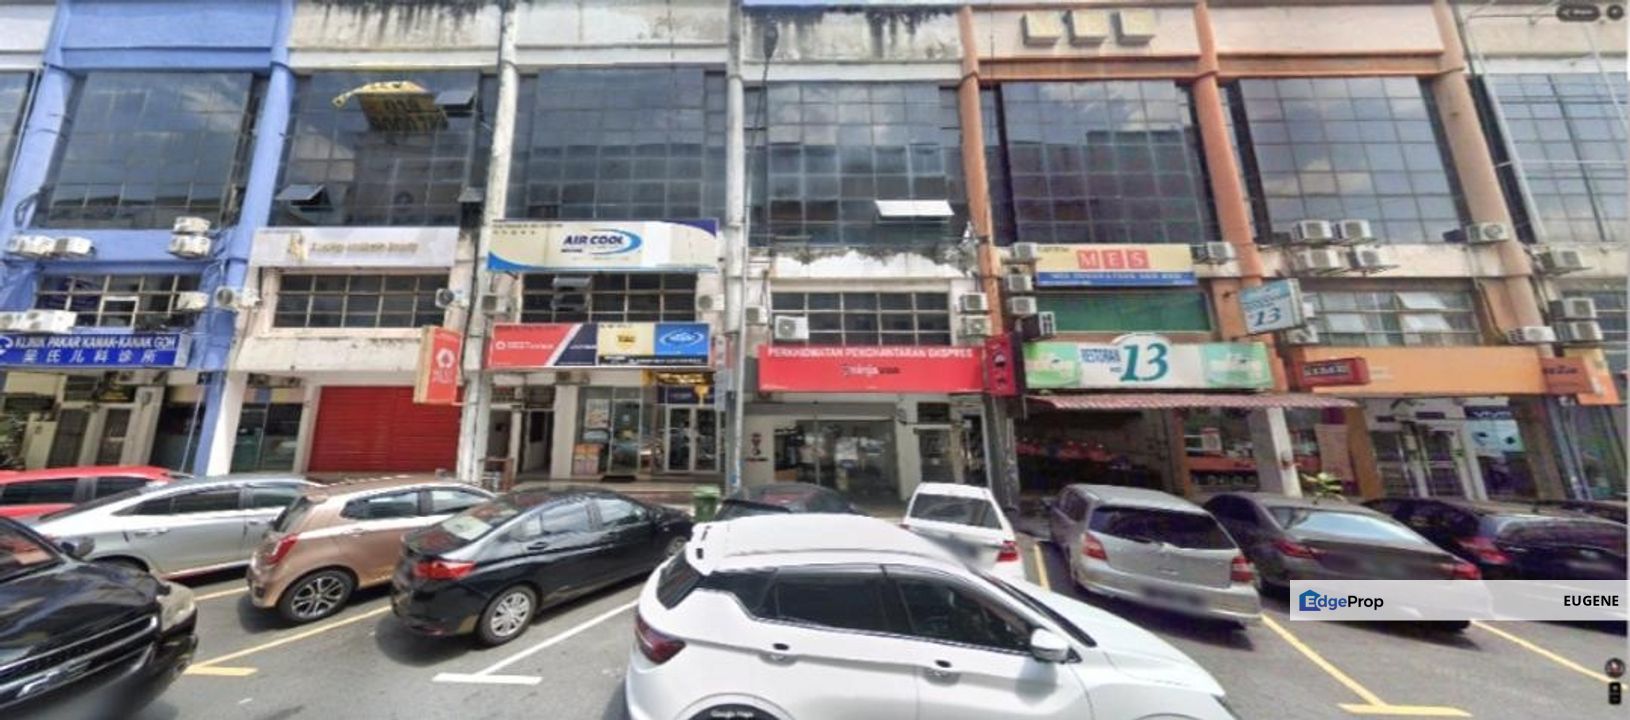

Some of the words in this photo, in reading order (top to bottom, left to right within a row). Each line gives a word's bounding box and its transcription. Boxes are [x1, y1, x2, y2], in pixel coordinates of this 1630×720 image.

[563, 235, 587, 245] AIR
[589, 235, 624, 245] COOL
[1079, 251, 1147, 267] MES
[1254, 307, 1281, 326] 13
[47, 335, 81, 349] PAKAR
[82, 335, 152, 349] KANAK-KANAK
[1120, 343, 1169, 382] 13
